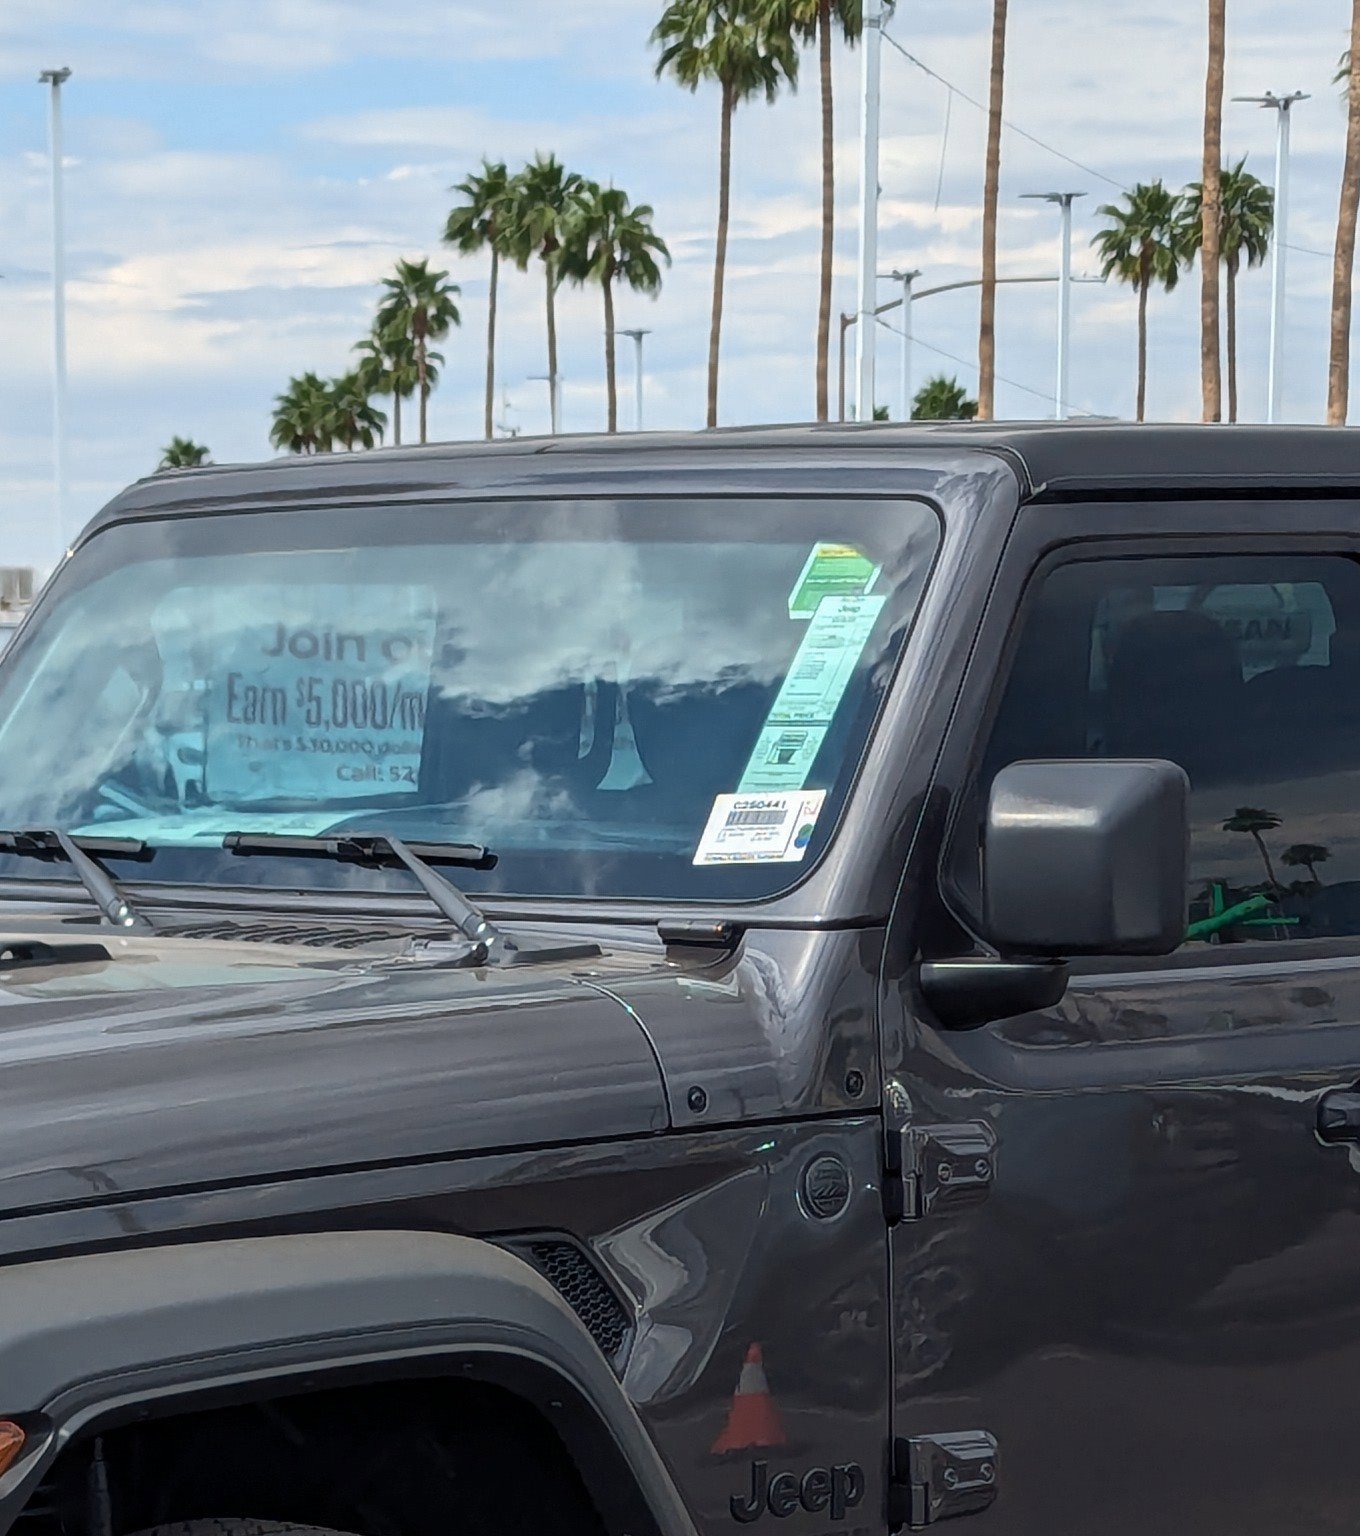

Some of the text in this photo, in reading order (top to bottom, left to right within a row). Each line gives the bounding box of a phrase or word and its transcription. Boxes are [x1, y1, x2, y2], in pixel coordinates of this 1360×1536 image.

[261, 622, 367, 662] Join
[225, 672, 426, 733] Earn $5,000/m
[729, 1458, 866, 1524] Jeep
